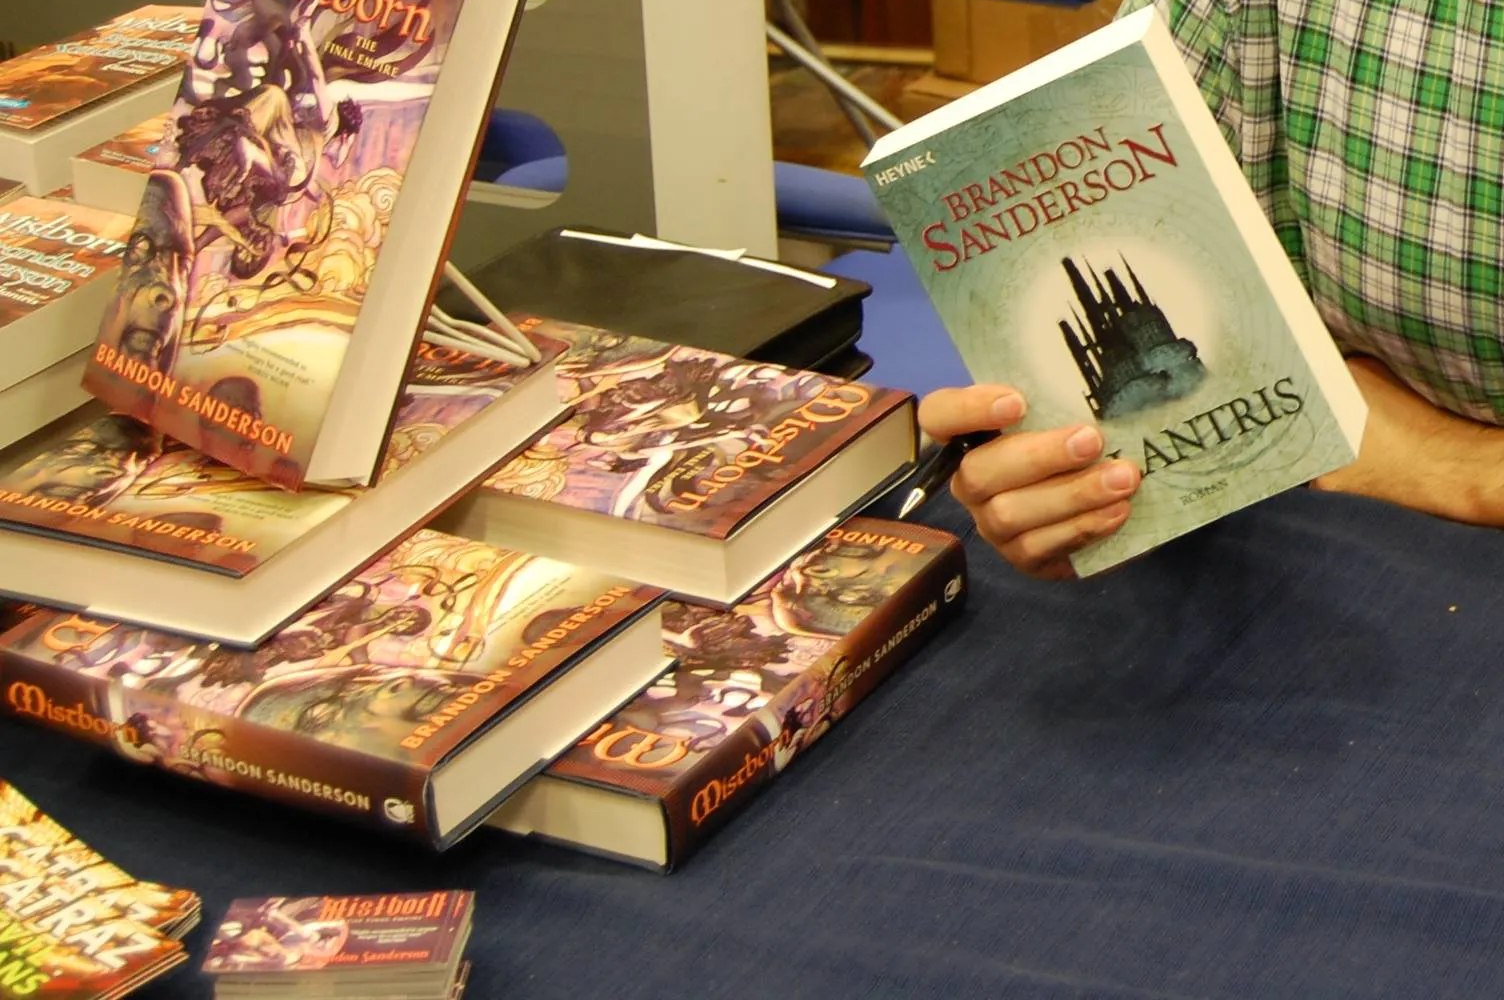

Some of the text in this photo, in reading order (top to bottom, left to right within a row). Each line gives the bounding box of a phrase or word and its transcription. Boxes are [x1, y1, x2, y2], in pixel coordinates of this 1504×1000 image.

[324, 41, 401, 80] FINAL EMPIRE
[355, 35, 378, 54] THE
[874, 157, 927, 187] HEYNE
[920, 122, 1198, 272] SANDERSON
[941, 125, 1113, 223] BRANDON
[95, 343, 294, 455] BRANDON SANDERSON
[1105, 376, 1303, 479] ANTRIS
[666, 383, 870, 511] Mistborn
[107, 509, 258, 554] SANDERSON
[826, 527, 929, 556] BRANDO
[400, 668, 513, 750] BRANDON
[508, 584, 632, 669] SANDERSON
[819, 599, 938, 717] BRANDON SANDERSON
[8, 681, 141, 747] Mistborn
[180, 744, 371, 811] BRANDON SANDERSON
[690, 730, 796, 827] Mistborn
[0, 860, 162, 971] ATRAZ
[319, 891, 449, 923] Mistborn
[361, 948, 433, 966] Sanderson
